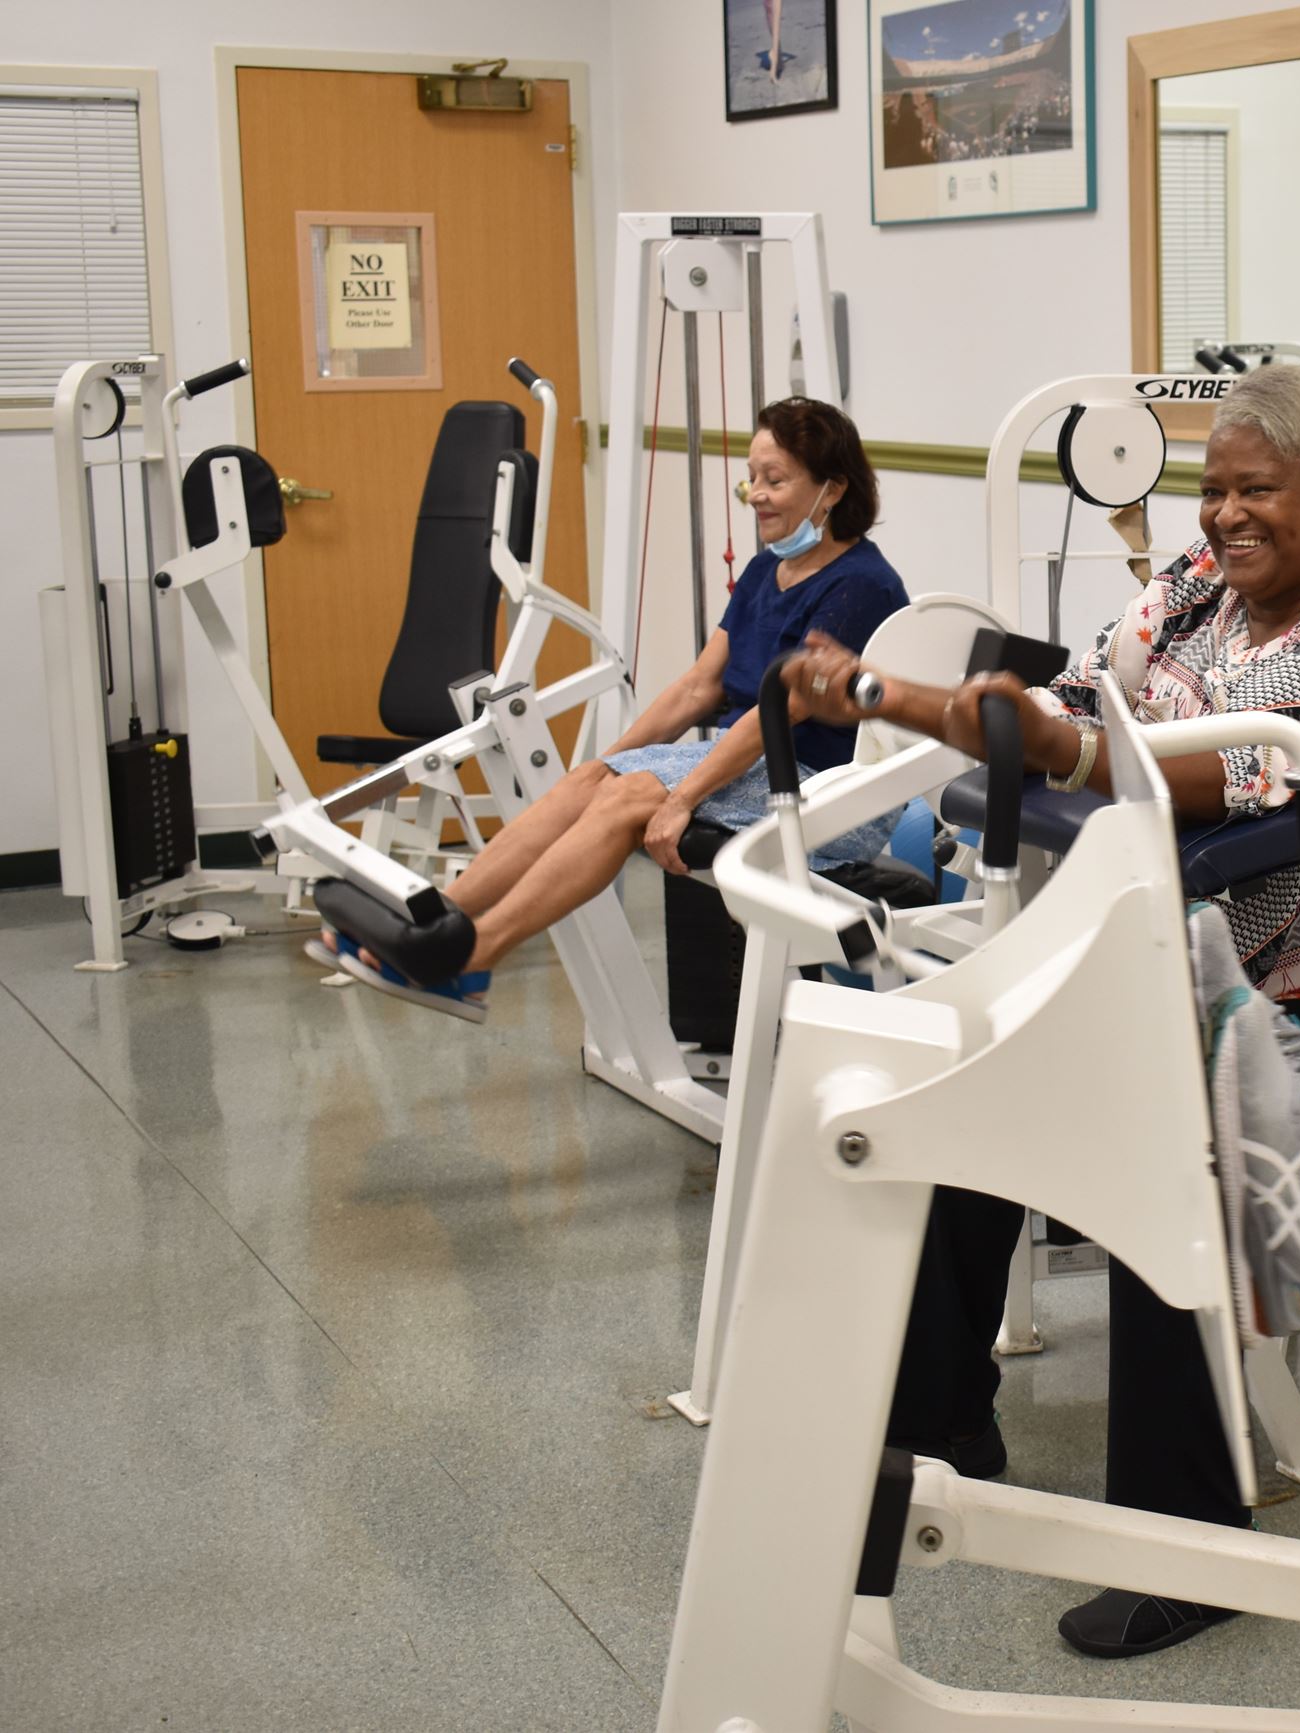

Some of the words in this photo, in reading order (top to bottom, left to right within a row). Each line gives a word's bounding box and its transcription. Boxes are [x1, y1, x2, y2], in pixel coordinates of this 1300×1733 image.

[350, 253, 383, 271] NO
[341, 279, 396, 298] EXIT
[347, 308, 374, 317] Please
[375, 308, 392, 317] Use
[345, 319, 371, 329] Other
[373, 319, 394, 329] Door
[1169, 379, 1238, 400] CYBE
